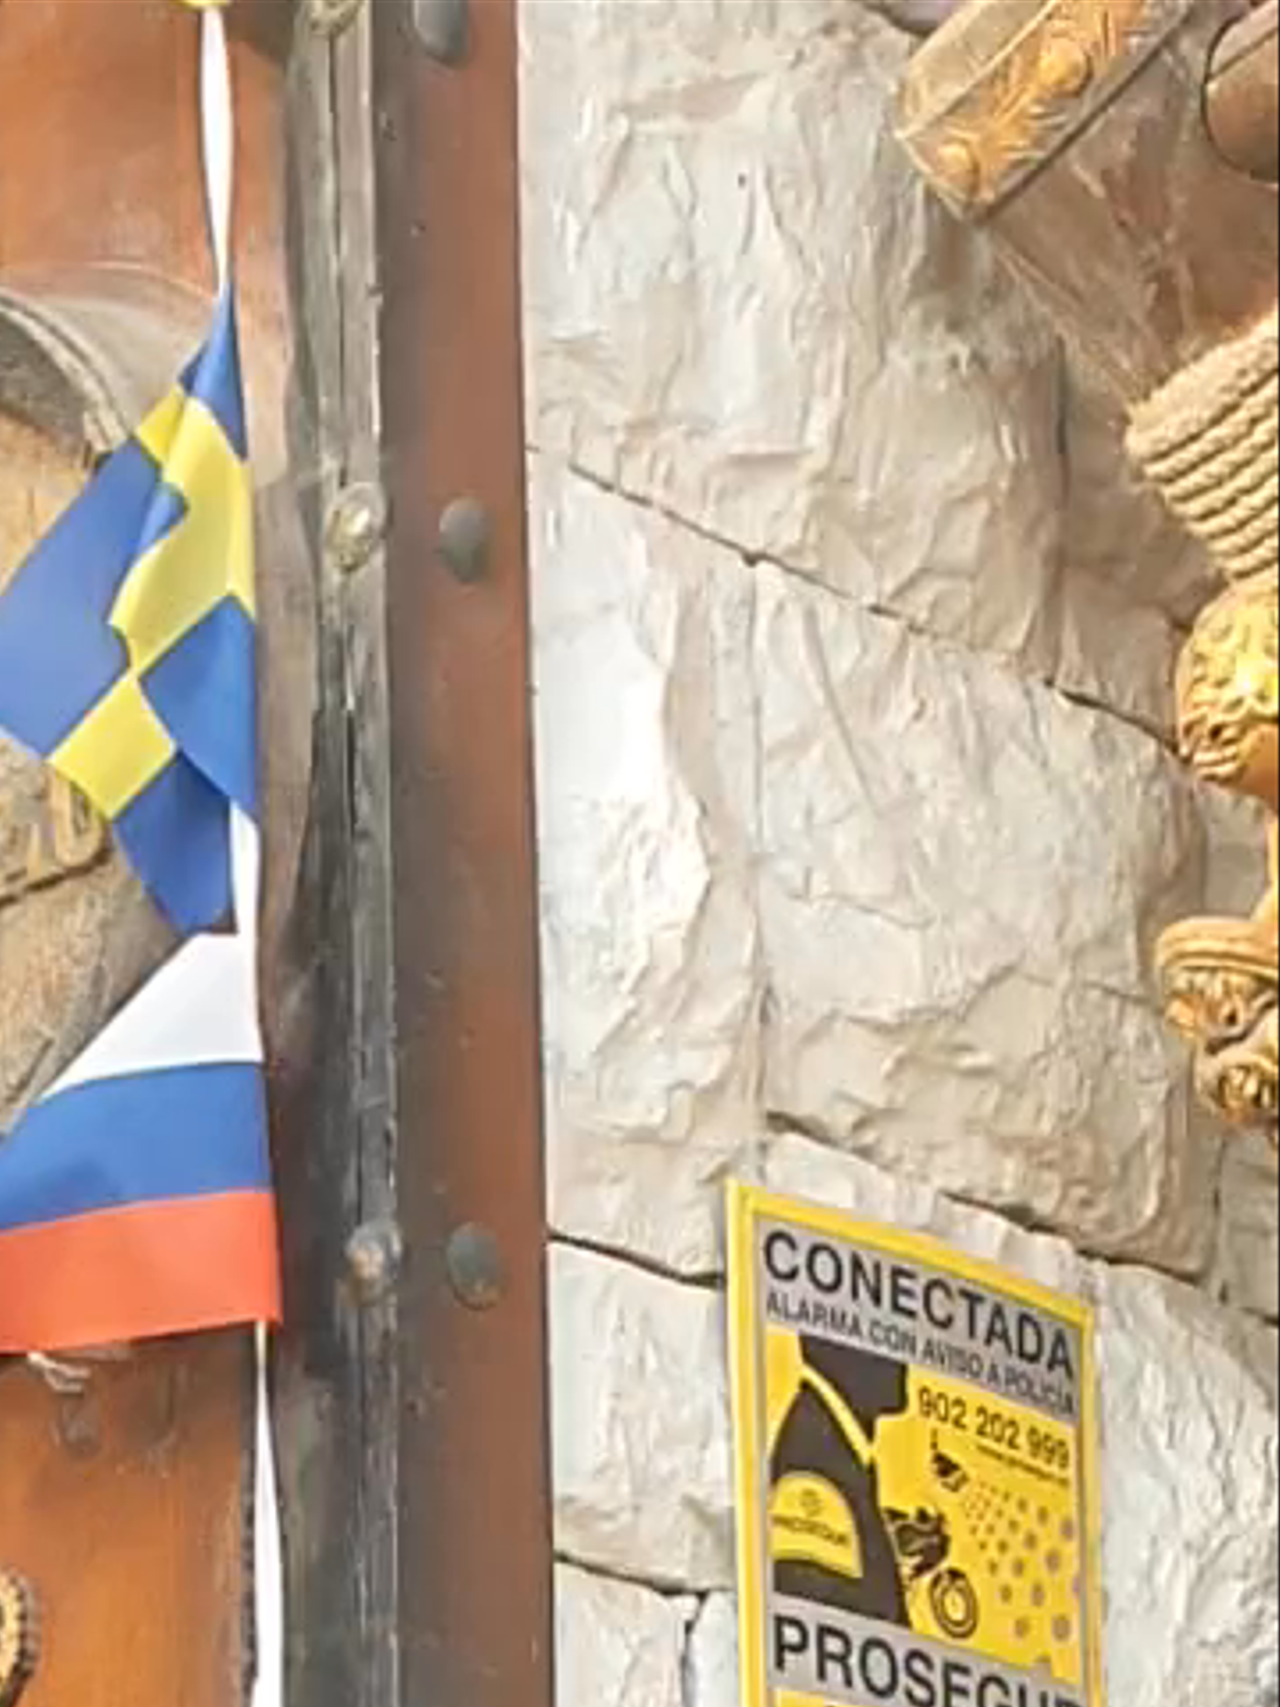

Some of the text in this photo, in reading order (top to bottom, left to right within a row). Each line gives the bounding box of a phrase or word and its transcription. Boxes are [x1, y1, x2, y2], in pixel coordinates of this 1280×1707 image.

[763, 1230, 1074, 1380] CONECTADA
[765, 1291, 864, 1340] ALARMA
[869, 1320, 919, 1356] CON
[922, 1338, 984, 1378] AVISO
[987, 1362, 1003, 1387] A
[918, 1385, 968, 1431] 902
[975, 1405, 1021, 1451] 202
